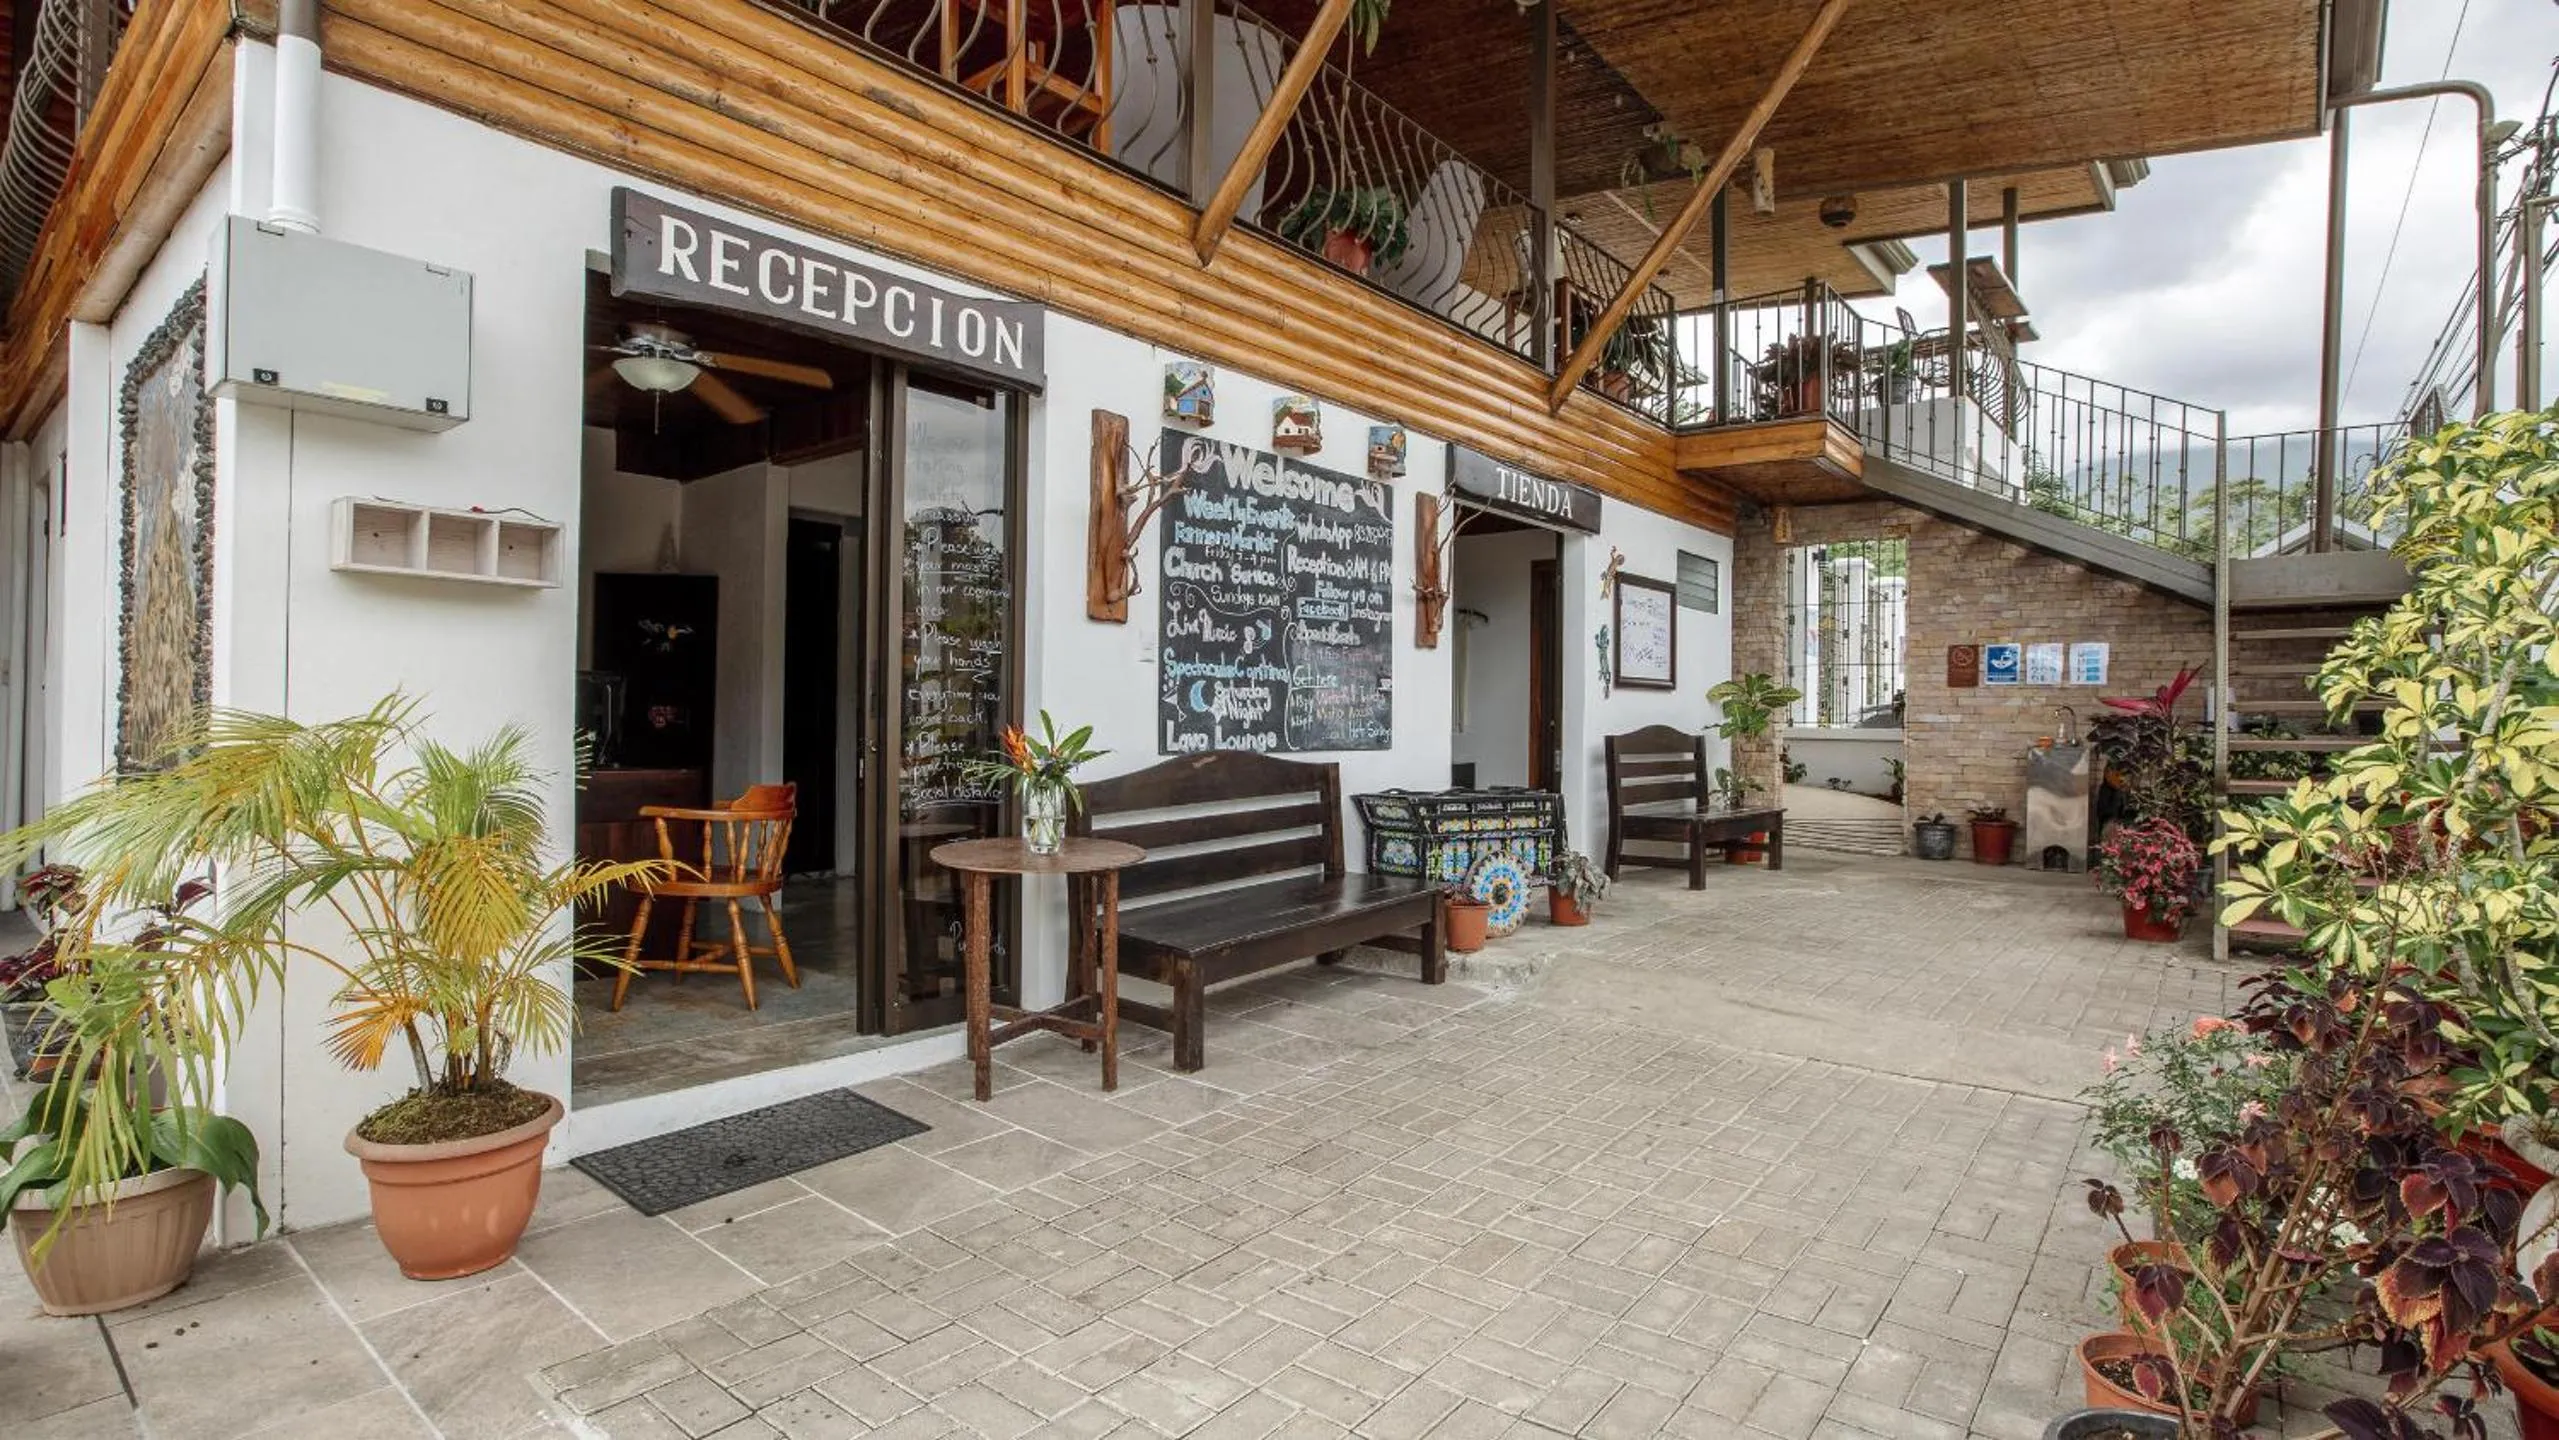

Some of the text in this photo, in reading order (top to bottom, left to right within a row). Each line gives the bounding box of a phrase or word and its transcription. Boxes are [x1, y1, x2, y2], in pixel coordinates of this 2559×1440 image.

[658, 213, 1025, 370] RECEPCION
[1219, 439, 1356, 512] Welcome
[1496, 466, 1574, 520] TIENDA
[1163, 546, 1276, 586] Church Service
[1287, 543, 1346, 579] Reception
[1315, 580, 1350, 600] Follow
[1368, 592, 1384, 605] on
[922, 622, 962, 648] Please
[1199, 608, 1237, 642] Music
[950, 650, 990, 668] hands
[918, 731, 965, 755] Please
[1167, 720, 1277, 754] Lava Lounge
